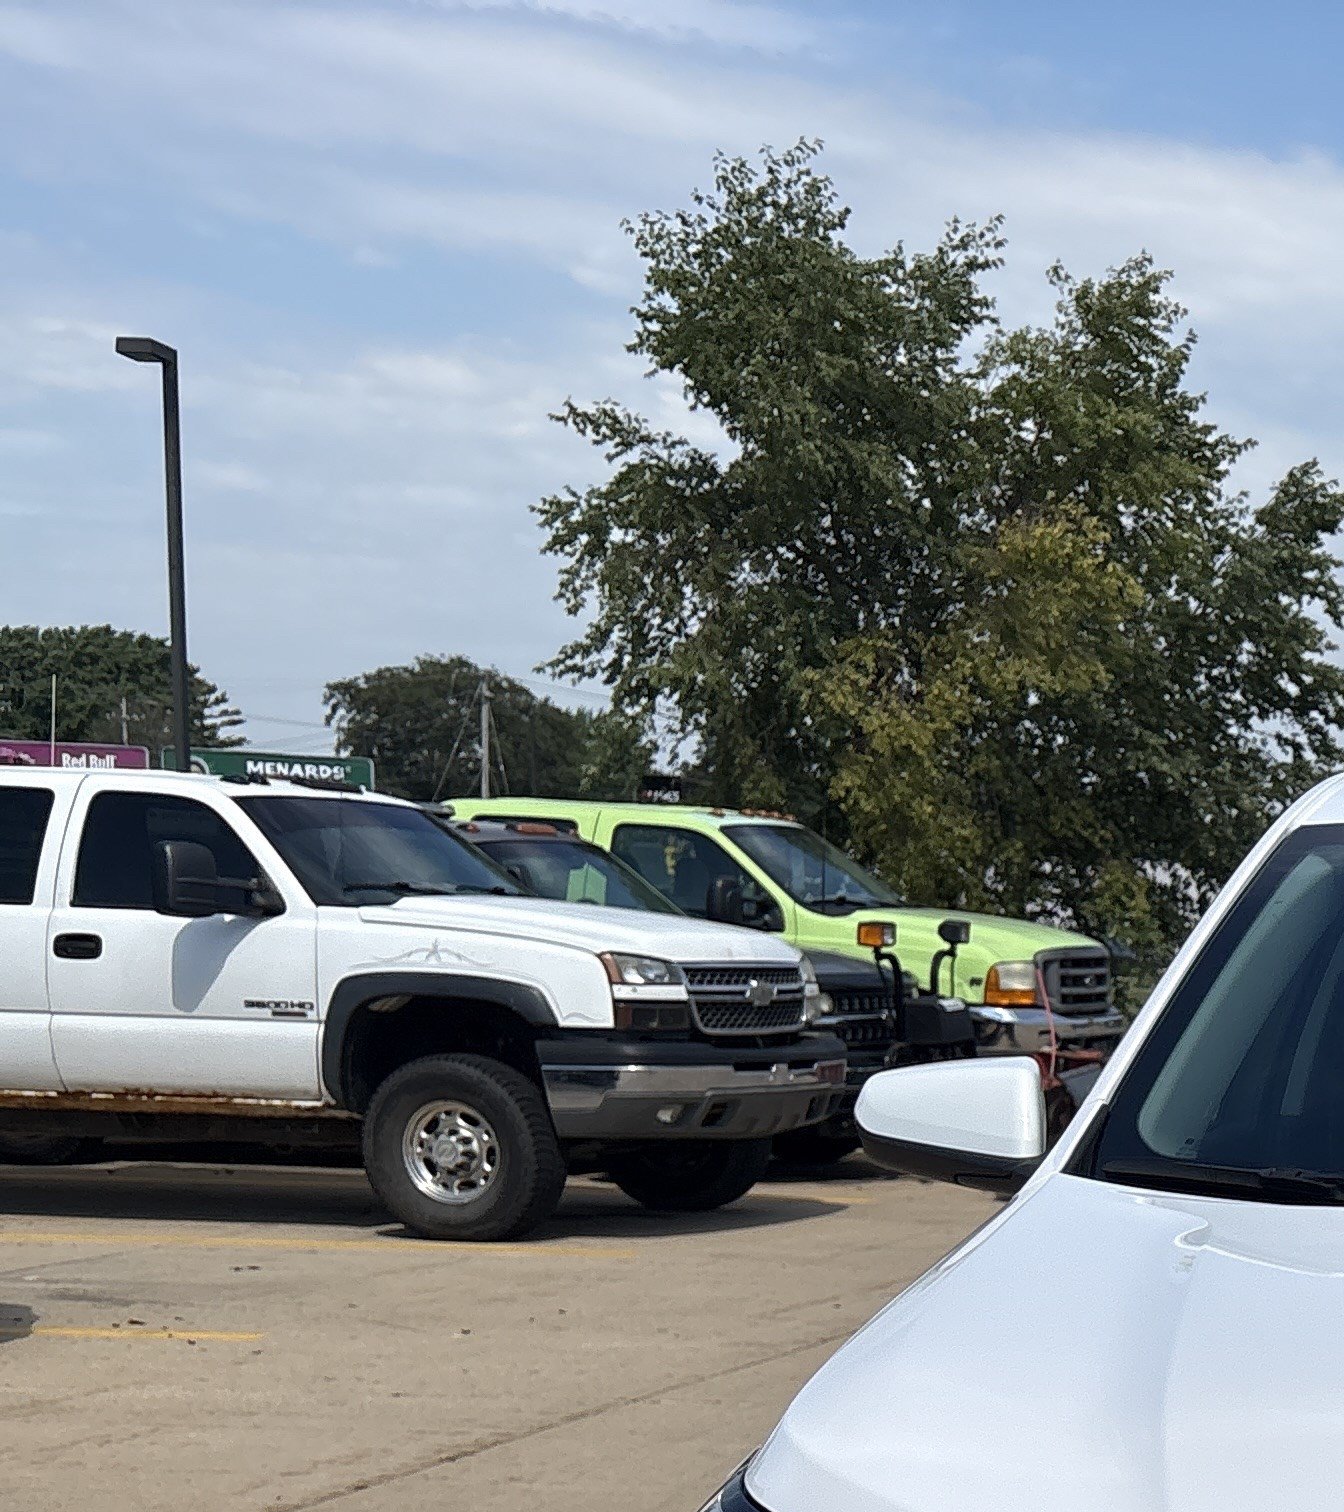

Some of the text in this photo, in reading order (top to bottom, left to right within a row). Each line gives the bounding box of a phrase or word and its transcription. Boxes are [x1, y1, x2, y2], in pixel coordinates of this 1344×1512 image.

[62, 752, 115, 769] Red Bull
[245, 760, 346, 781] MENARDS
